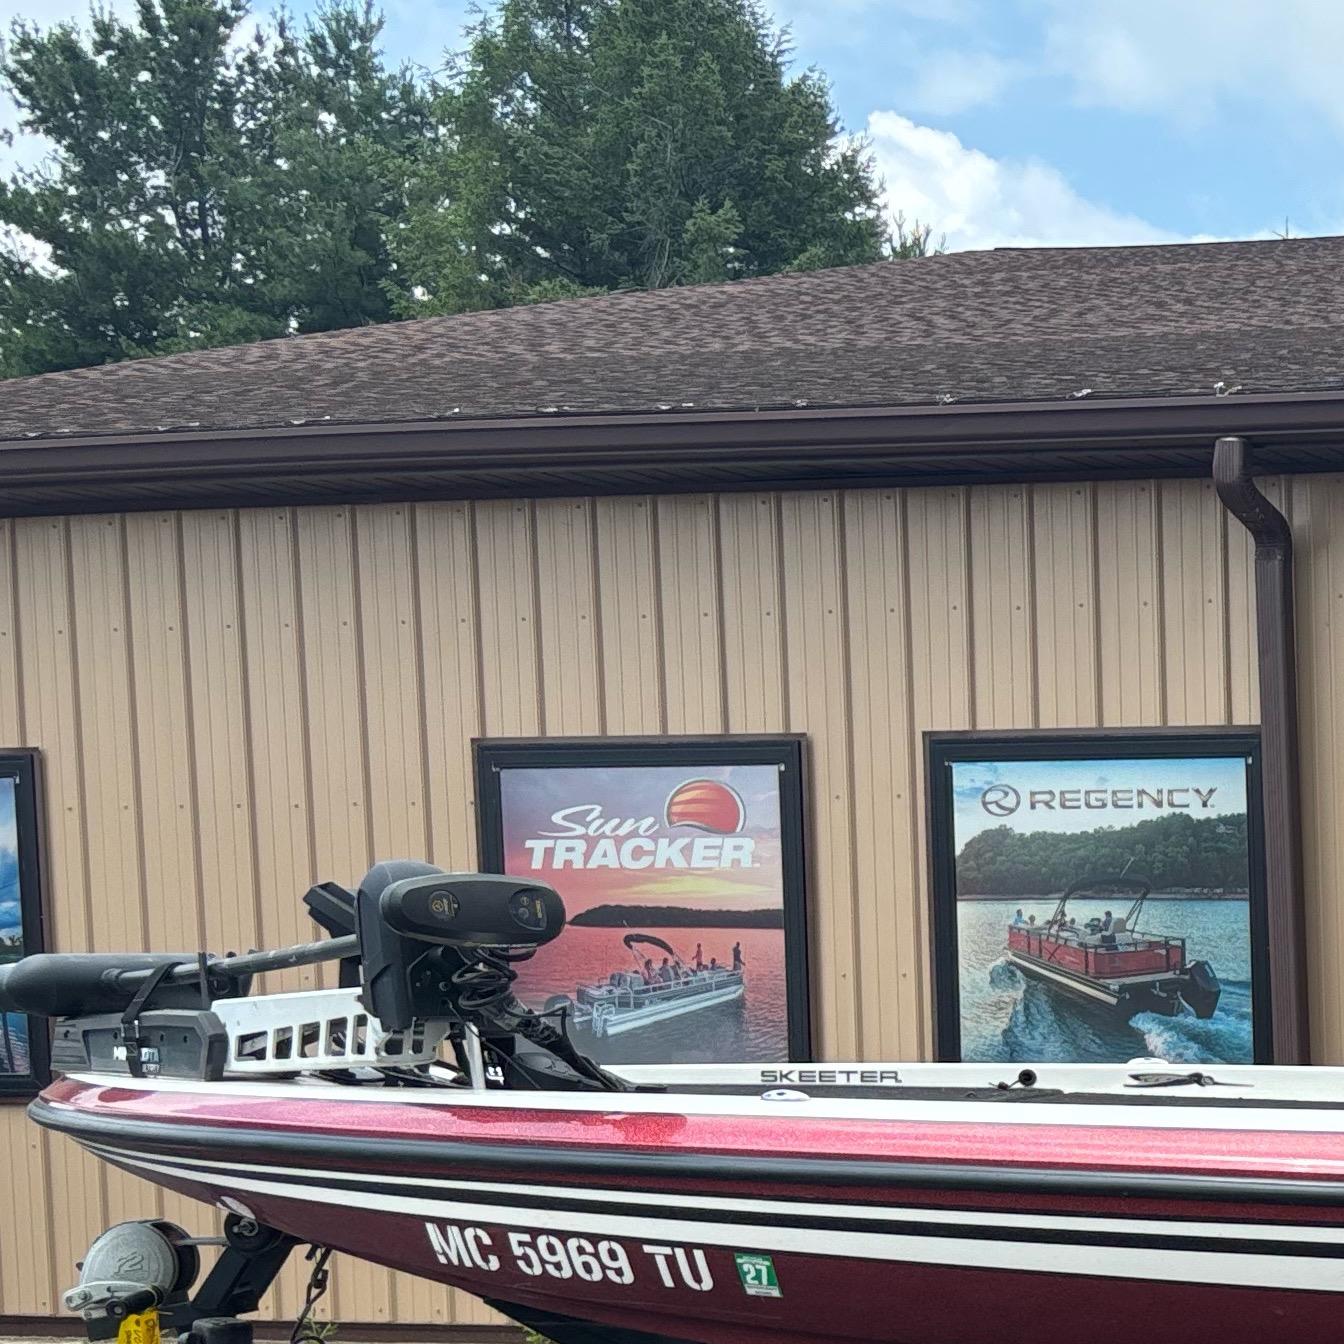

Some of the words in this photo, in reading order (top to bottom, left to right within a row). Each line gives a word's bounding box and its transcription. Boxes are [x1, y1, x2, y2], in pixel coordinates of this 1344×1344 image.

[1029, 787, 1217, 810] REGENCY
[538, 803, 660, 838] Sun
[524, 837, 756, 870] TRACKER
[760, 1070, 900, 1083] SKEETER
[425, 1222, 500, 1272] MC
[508, 1232, 635, 1285] 5969
[642, 1244, 714, 1291] TU
[742, 1263, 769, 1286] 27
